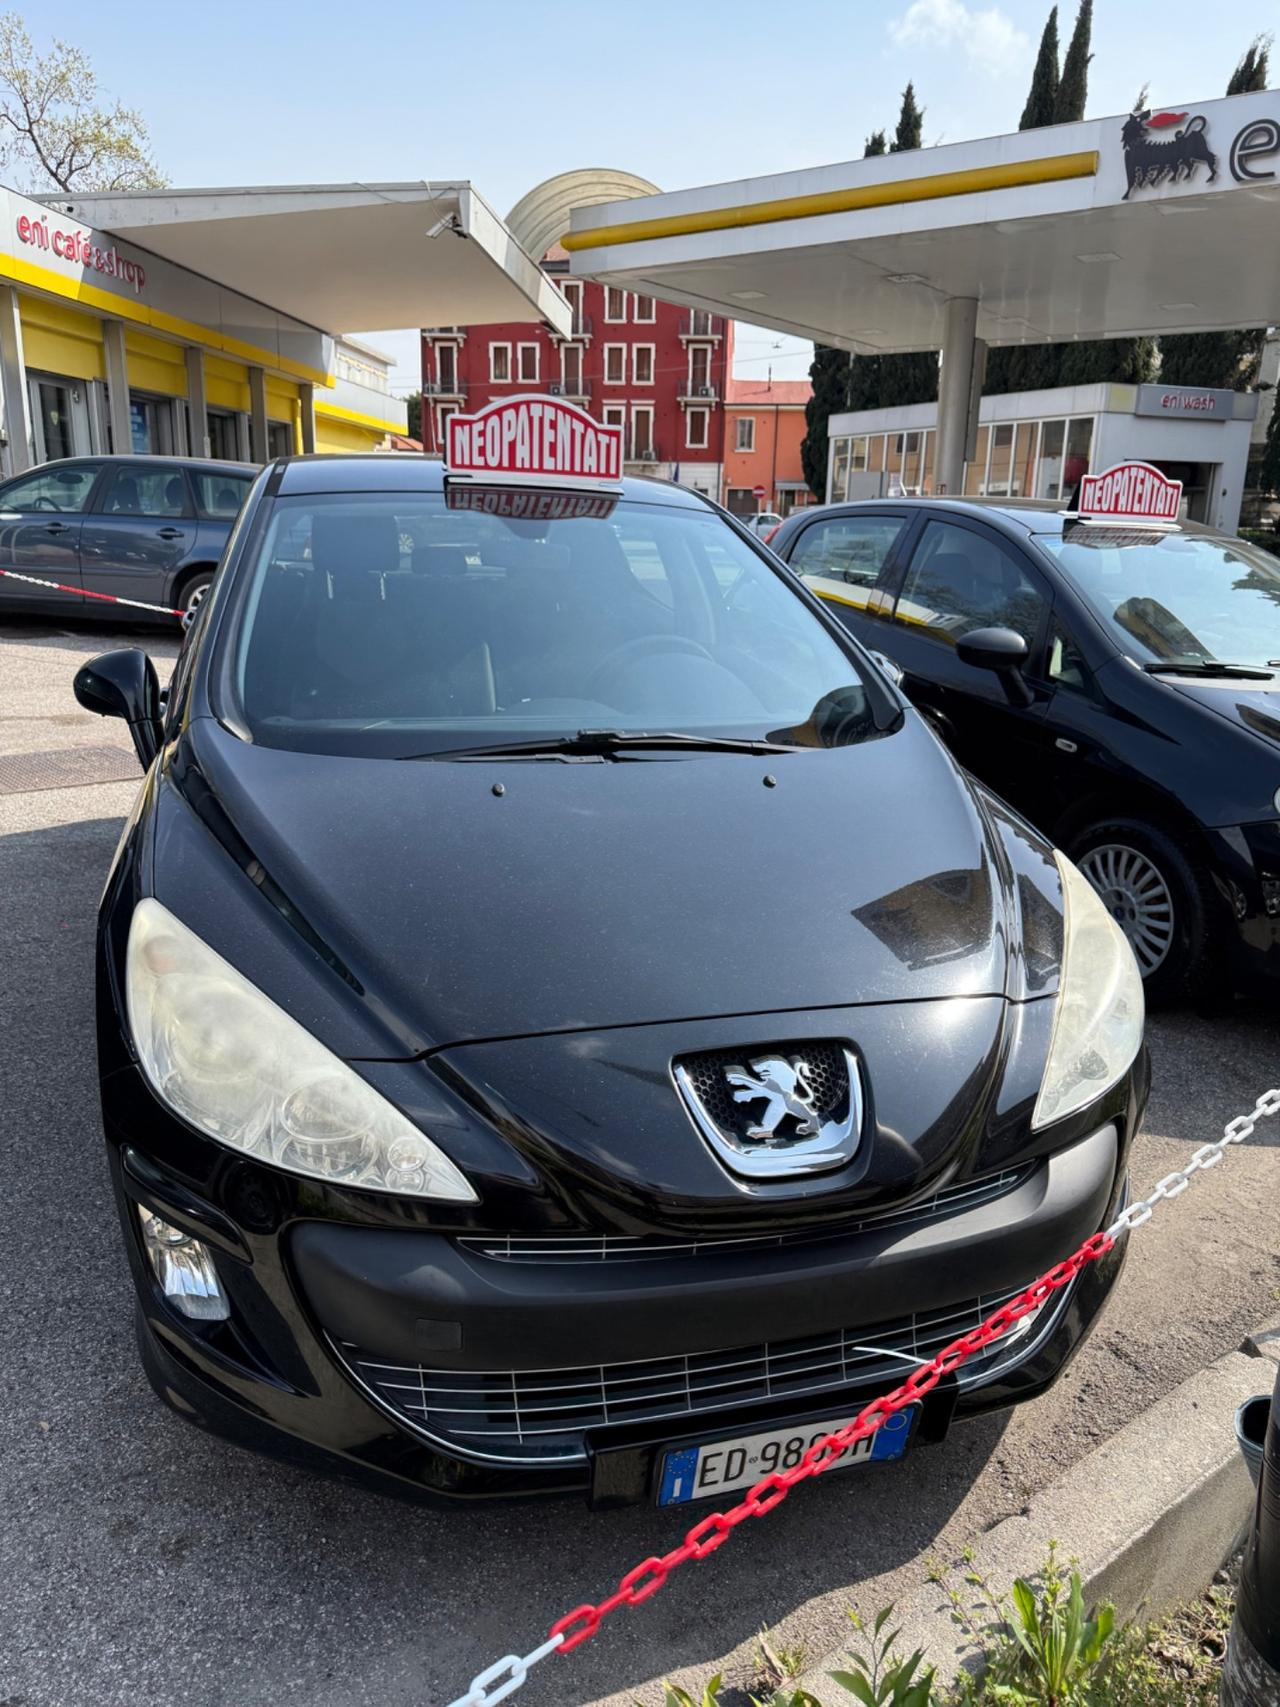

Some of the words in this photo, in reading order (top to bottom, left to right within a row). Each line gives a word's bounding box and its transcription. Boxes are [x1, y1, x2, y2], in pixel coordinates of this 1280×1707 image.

[17, 215, 49, 251] eni
[1161, 391, 1180, 409] eni
[1182, 394, 1216, 410] wash
[454, 403, 617, 475] NEOPATENTATI
[1083, 467, 1178, 516] NEOPATENTATI
[698, 1447, 747, 1488] ED
